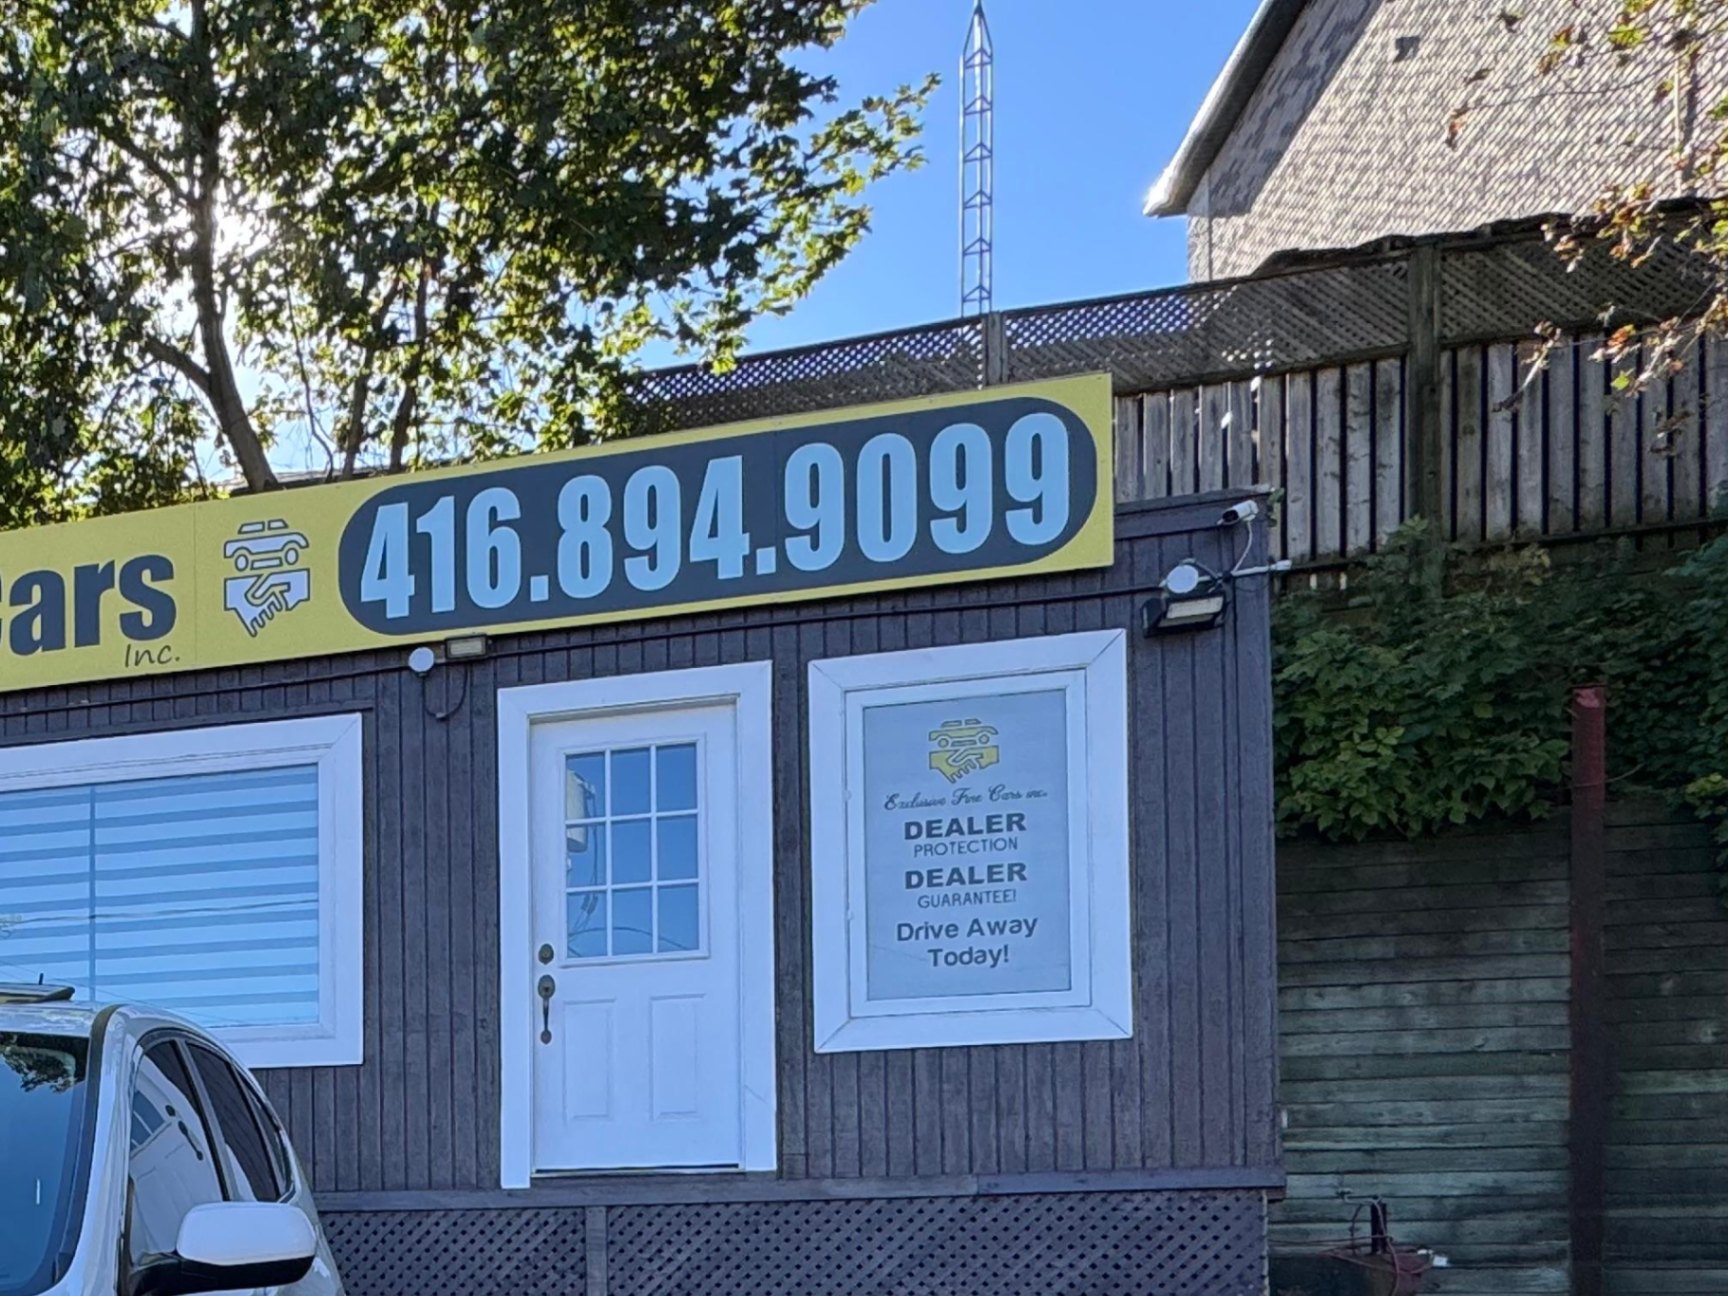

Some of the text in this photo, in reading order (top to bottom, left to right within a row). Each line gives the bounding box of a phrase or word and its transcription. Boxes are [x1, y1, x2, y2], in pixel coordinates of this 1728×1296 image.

[361, 412, 1071, 619] 416.894.9099
[123, 644, 181, 669] Inc.
[904, 812, 1027, 840] DEALER
[913, 837, 1018, 858] PROTECTION
[905, 862, 1027, 889] DEALER
[917, 889, 1017, 908] GUARANTEE!
[896, 917, 1038, 942] Drive Away
[927, 944, 1009, 968] Today!
